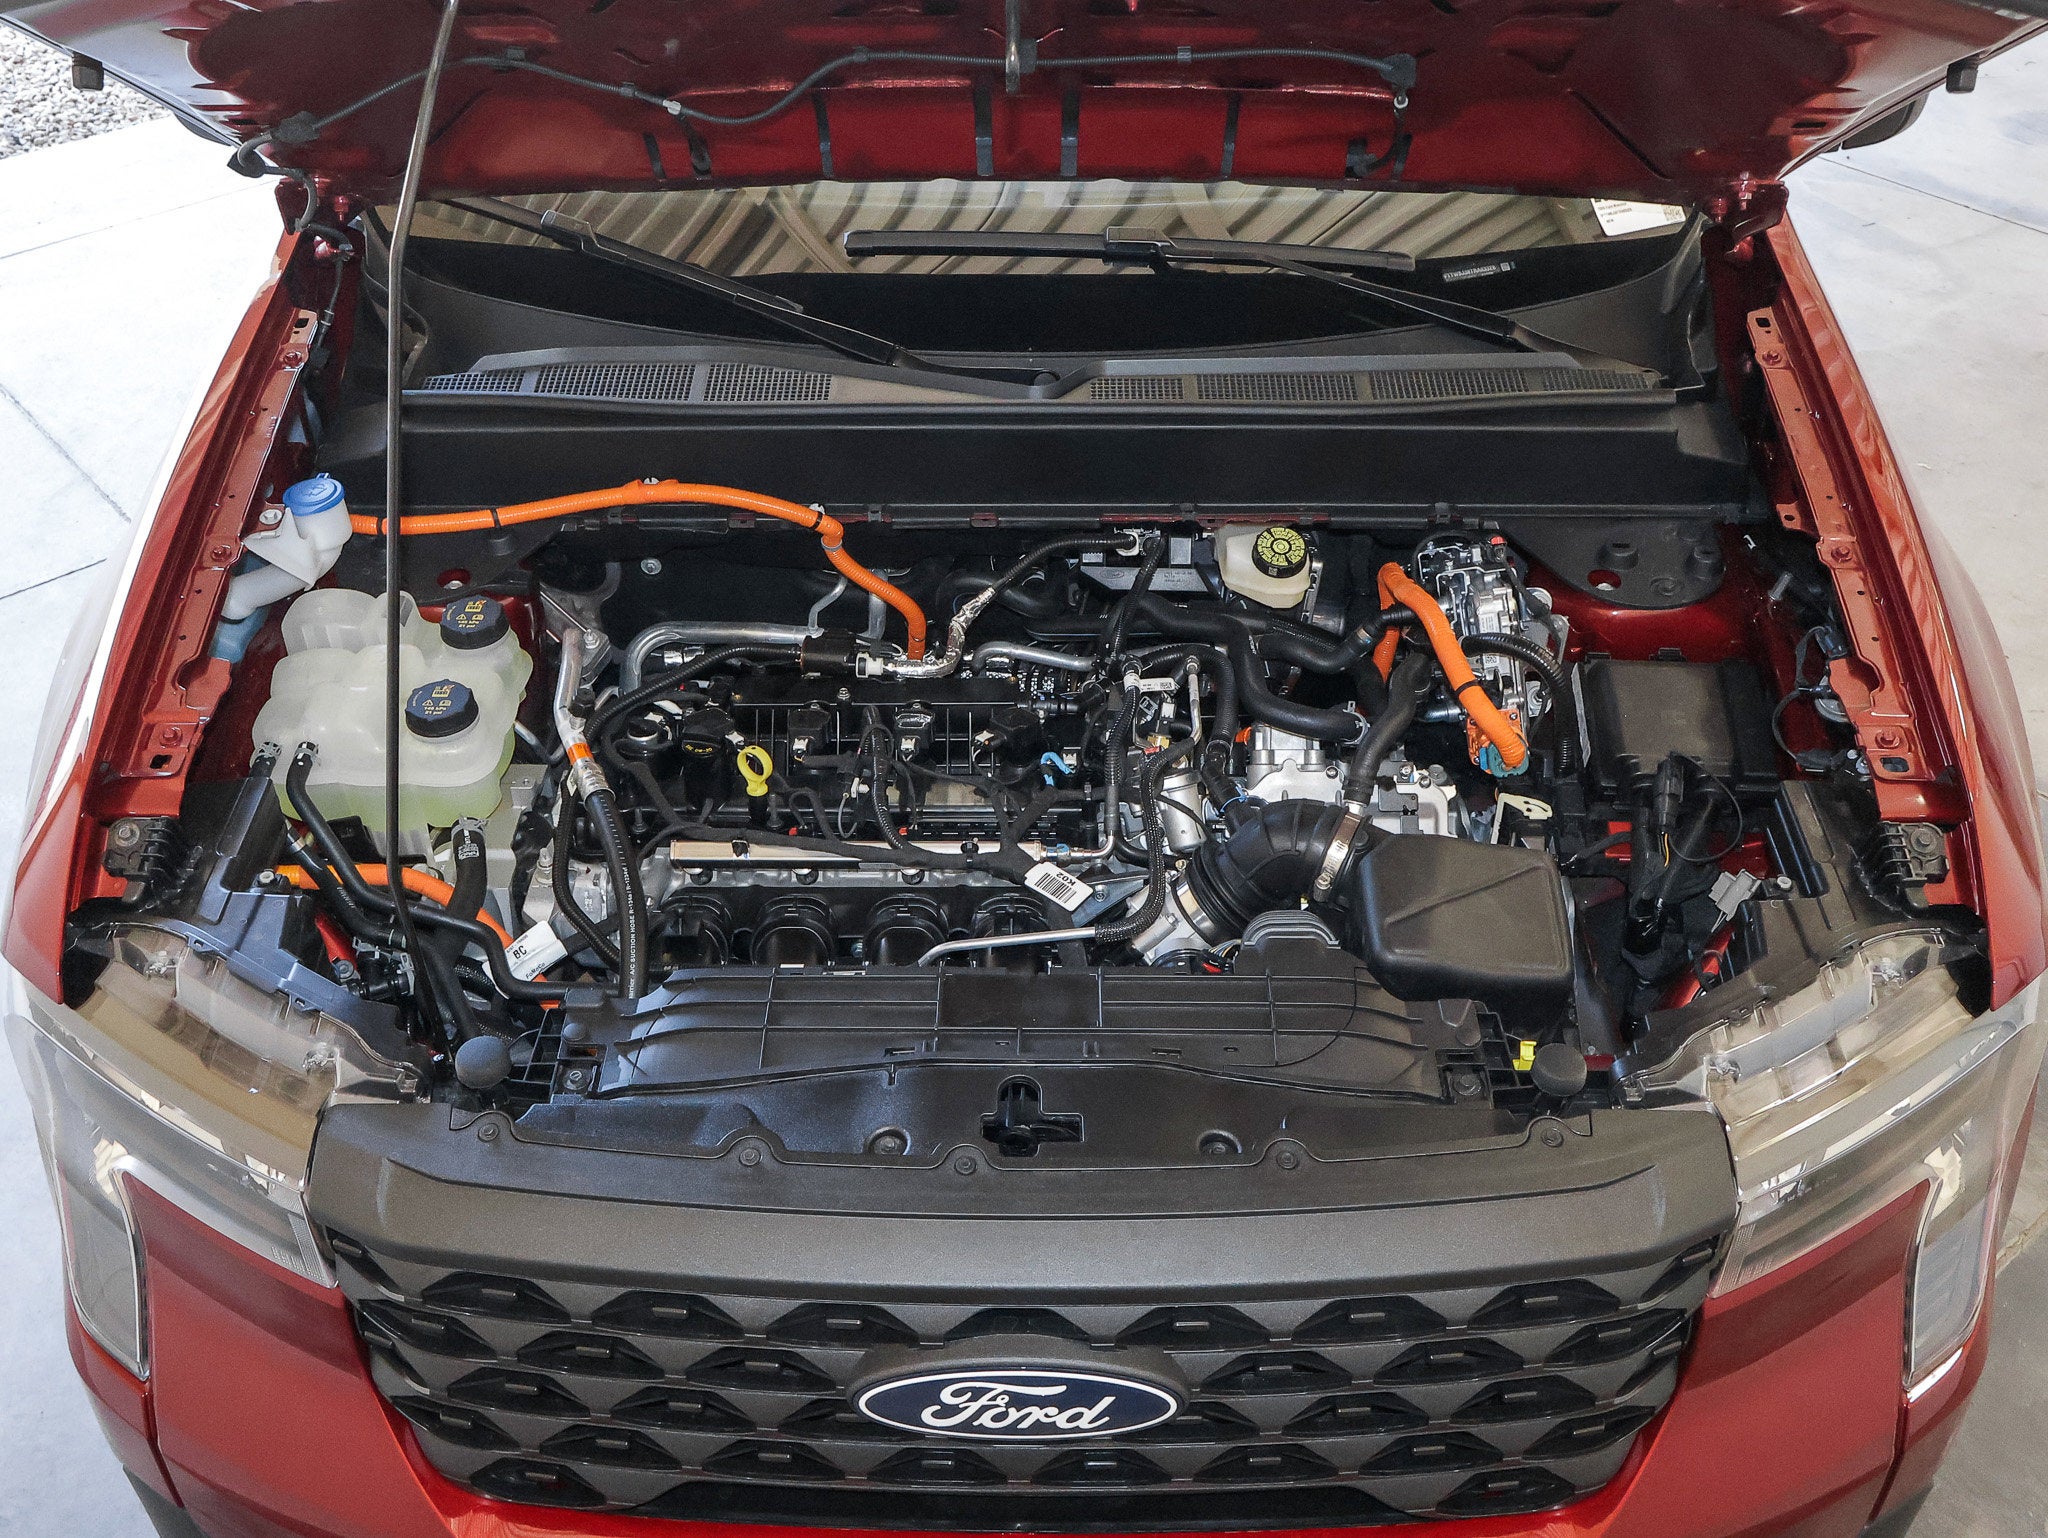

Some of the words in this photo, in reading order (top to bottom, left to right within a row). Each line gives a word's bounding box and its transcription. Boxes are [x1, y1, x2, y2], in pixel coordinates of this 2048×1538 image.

[1056, 871, 1077, 887] K02
[512, 945, 528, 960] BC
[525, 962, 546, 980] FoMoCo
[920, 1381, 1117, 1430] Ford
